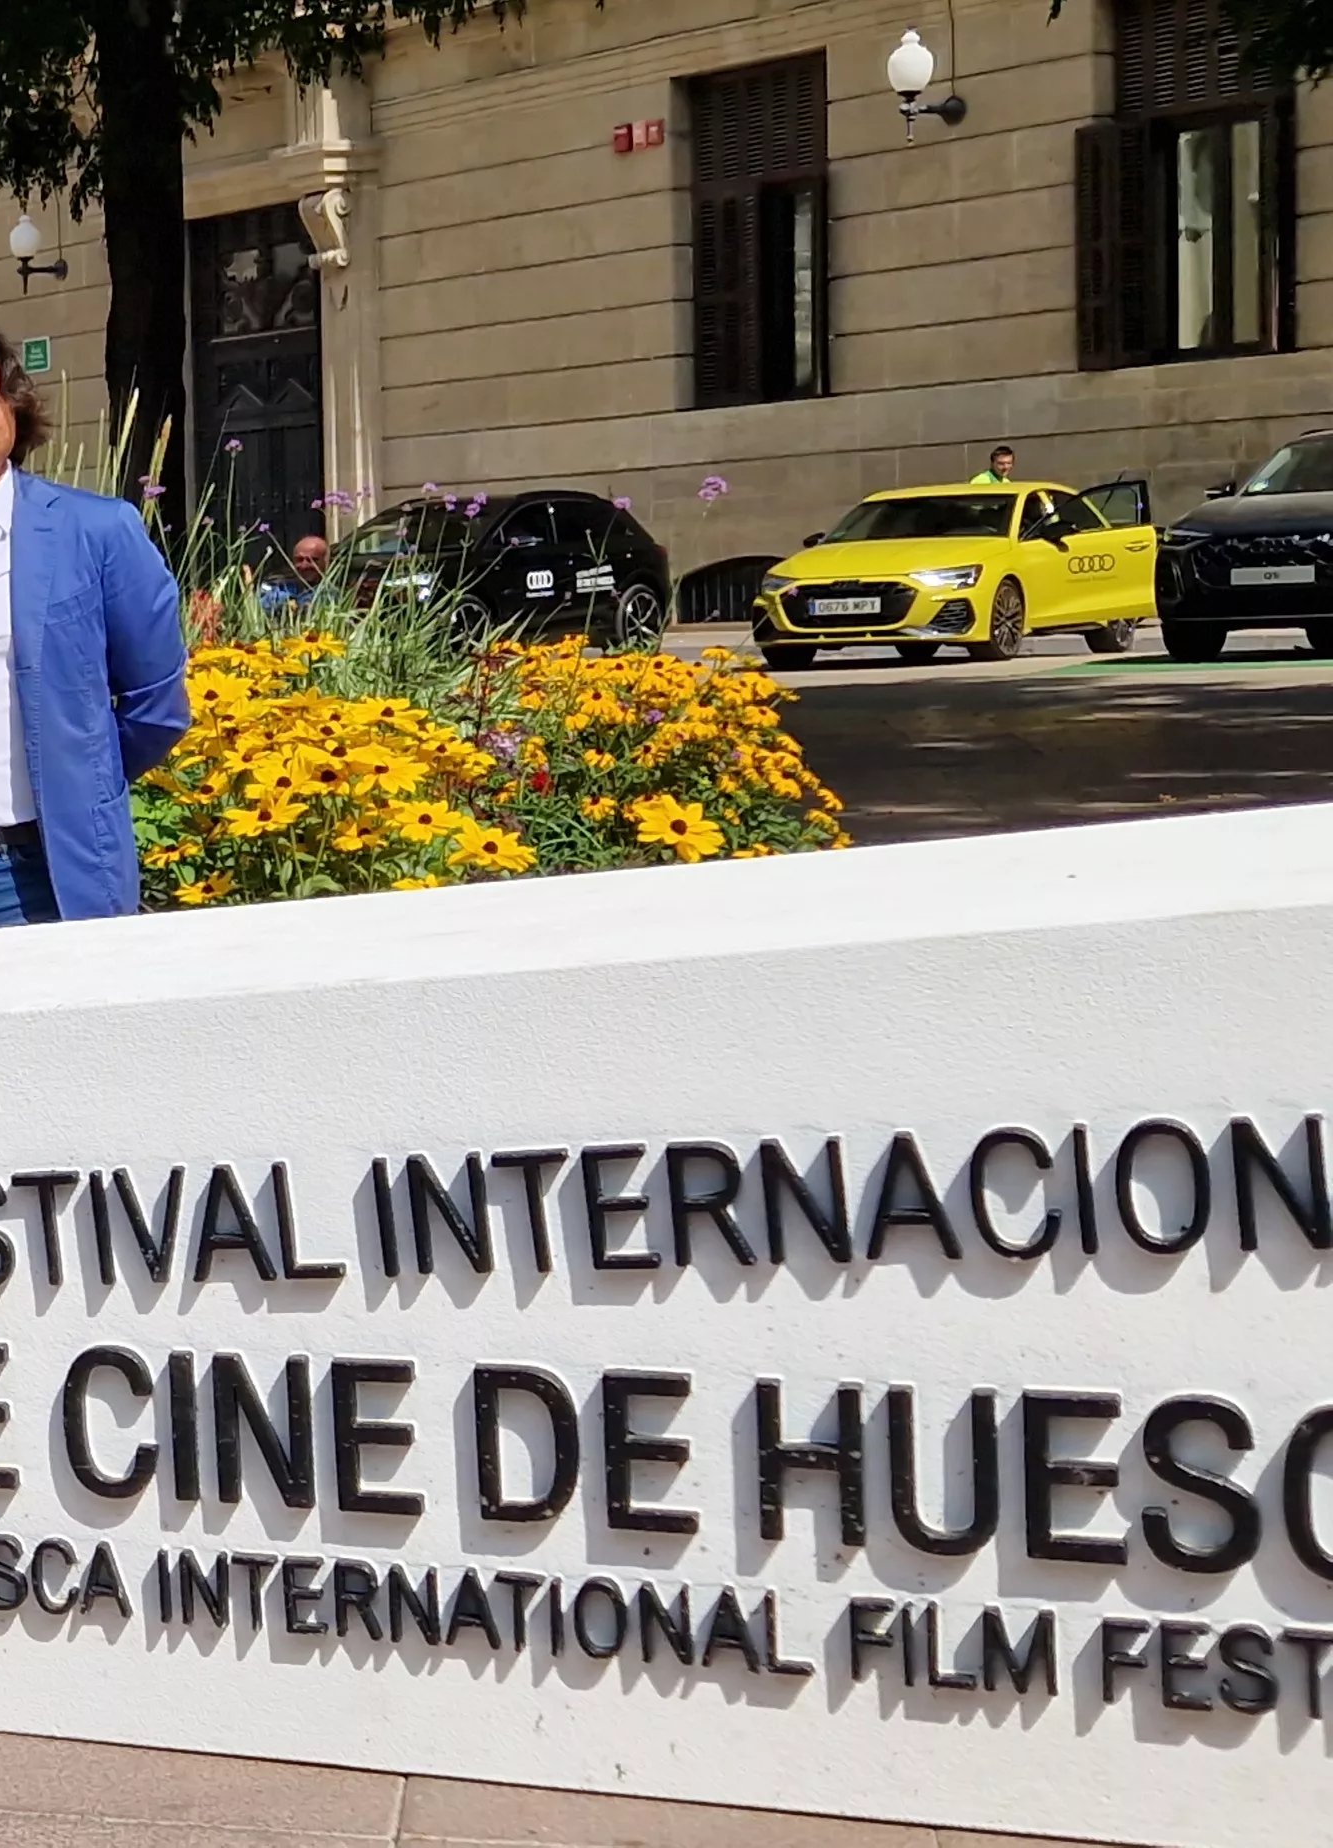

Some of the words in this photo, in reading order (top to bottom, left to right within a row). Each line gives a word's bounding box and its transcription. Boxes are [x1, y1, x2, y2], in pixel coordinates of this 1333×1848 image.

[371, 1114, 1333, 1279] INTERNACION
[61, 1345, 423, 1516] CINE
[473, 1364, 698, 1536] DE
[156, 1549, 812, 1678] INTERNATIONAL
[847, 1597, 1058, 1696] FILM
[1100, 1616, 1333, 1720] FEST
